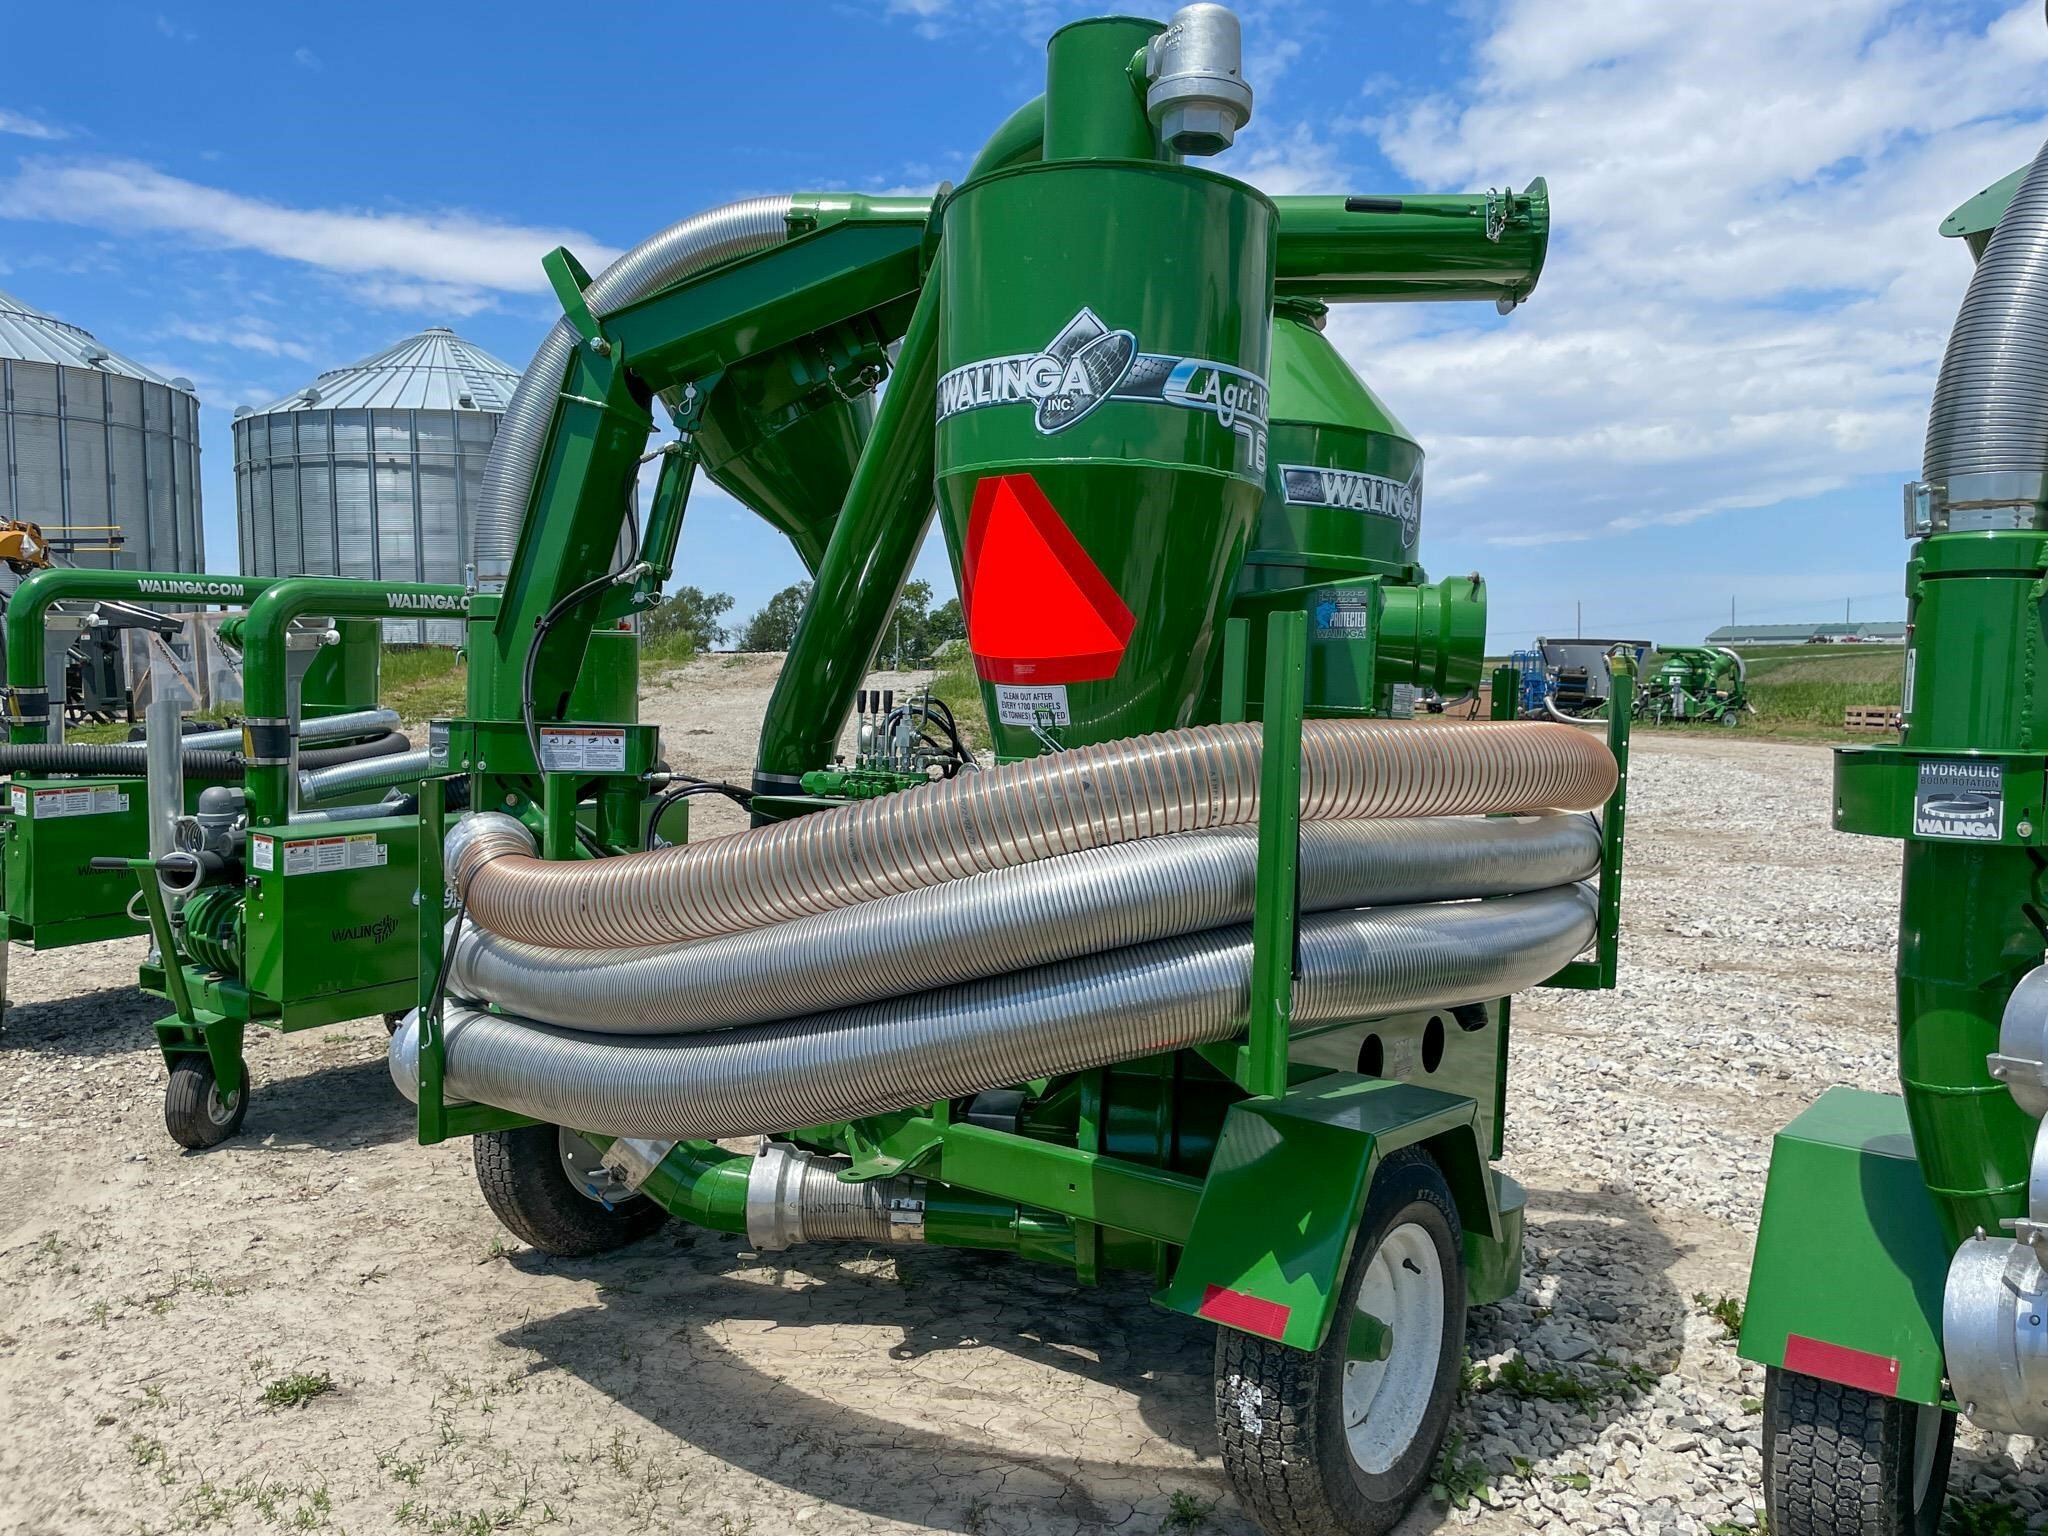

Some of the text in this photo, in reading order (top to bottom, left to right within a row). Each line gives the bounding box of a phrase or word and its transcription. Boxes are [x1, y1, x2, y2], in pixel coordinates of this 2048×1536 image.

[942, 354, 1093, 416] WALINGA
[1048, 399, 1074, 411] INC.
[1202, 369, 1268, 427] Agri-V
[1321, 472, 1418, 522] WALINGA
[387, 593, 470, 610] WALINGA.C
[1330, 611, 1366, 627] PROTECTED
[1003, 691, 1053, 701] CLEAN OUT AFTER
[1001, 701, 1016, 710] EVERY
[1921, 763, 2000, 778] HYDRAULIC
[1921, 776, 1999, 788] BOOM ROTATION
[1917, 818, 1998, 838] WALINGA
